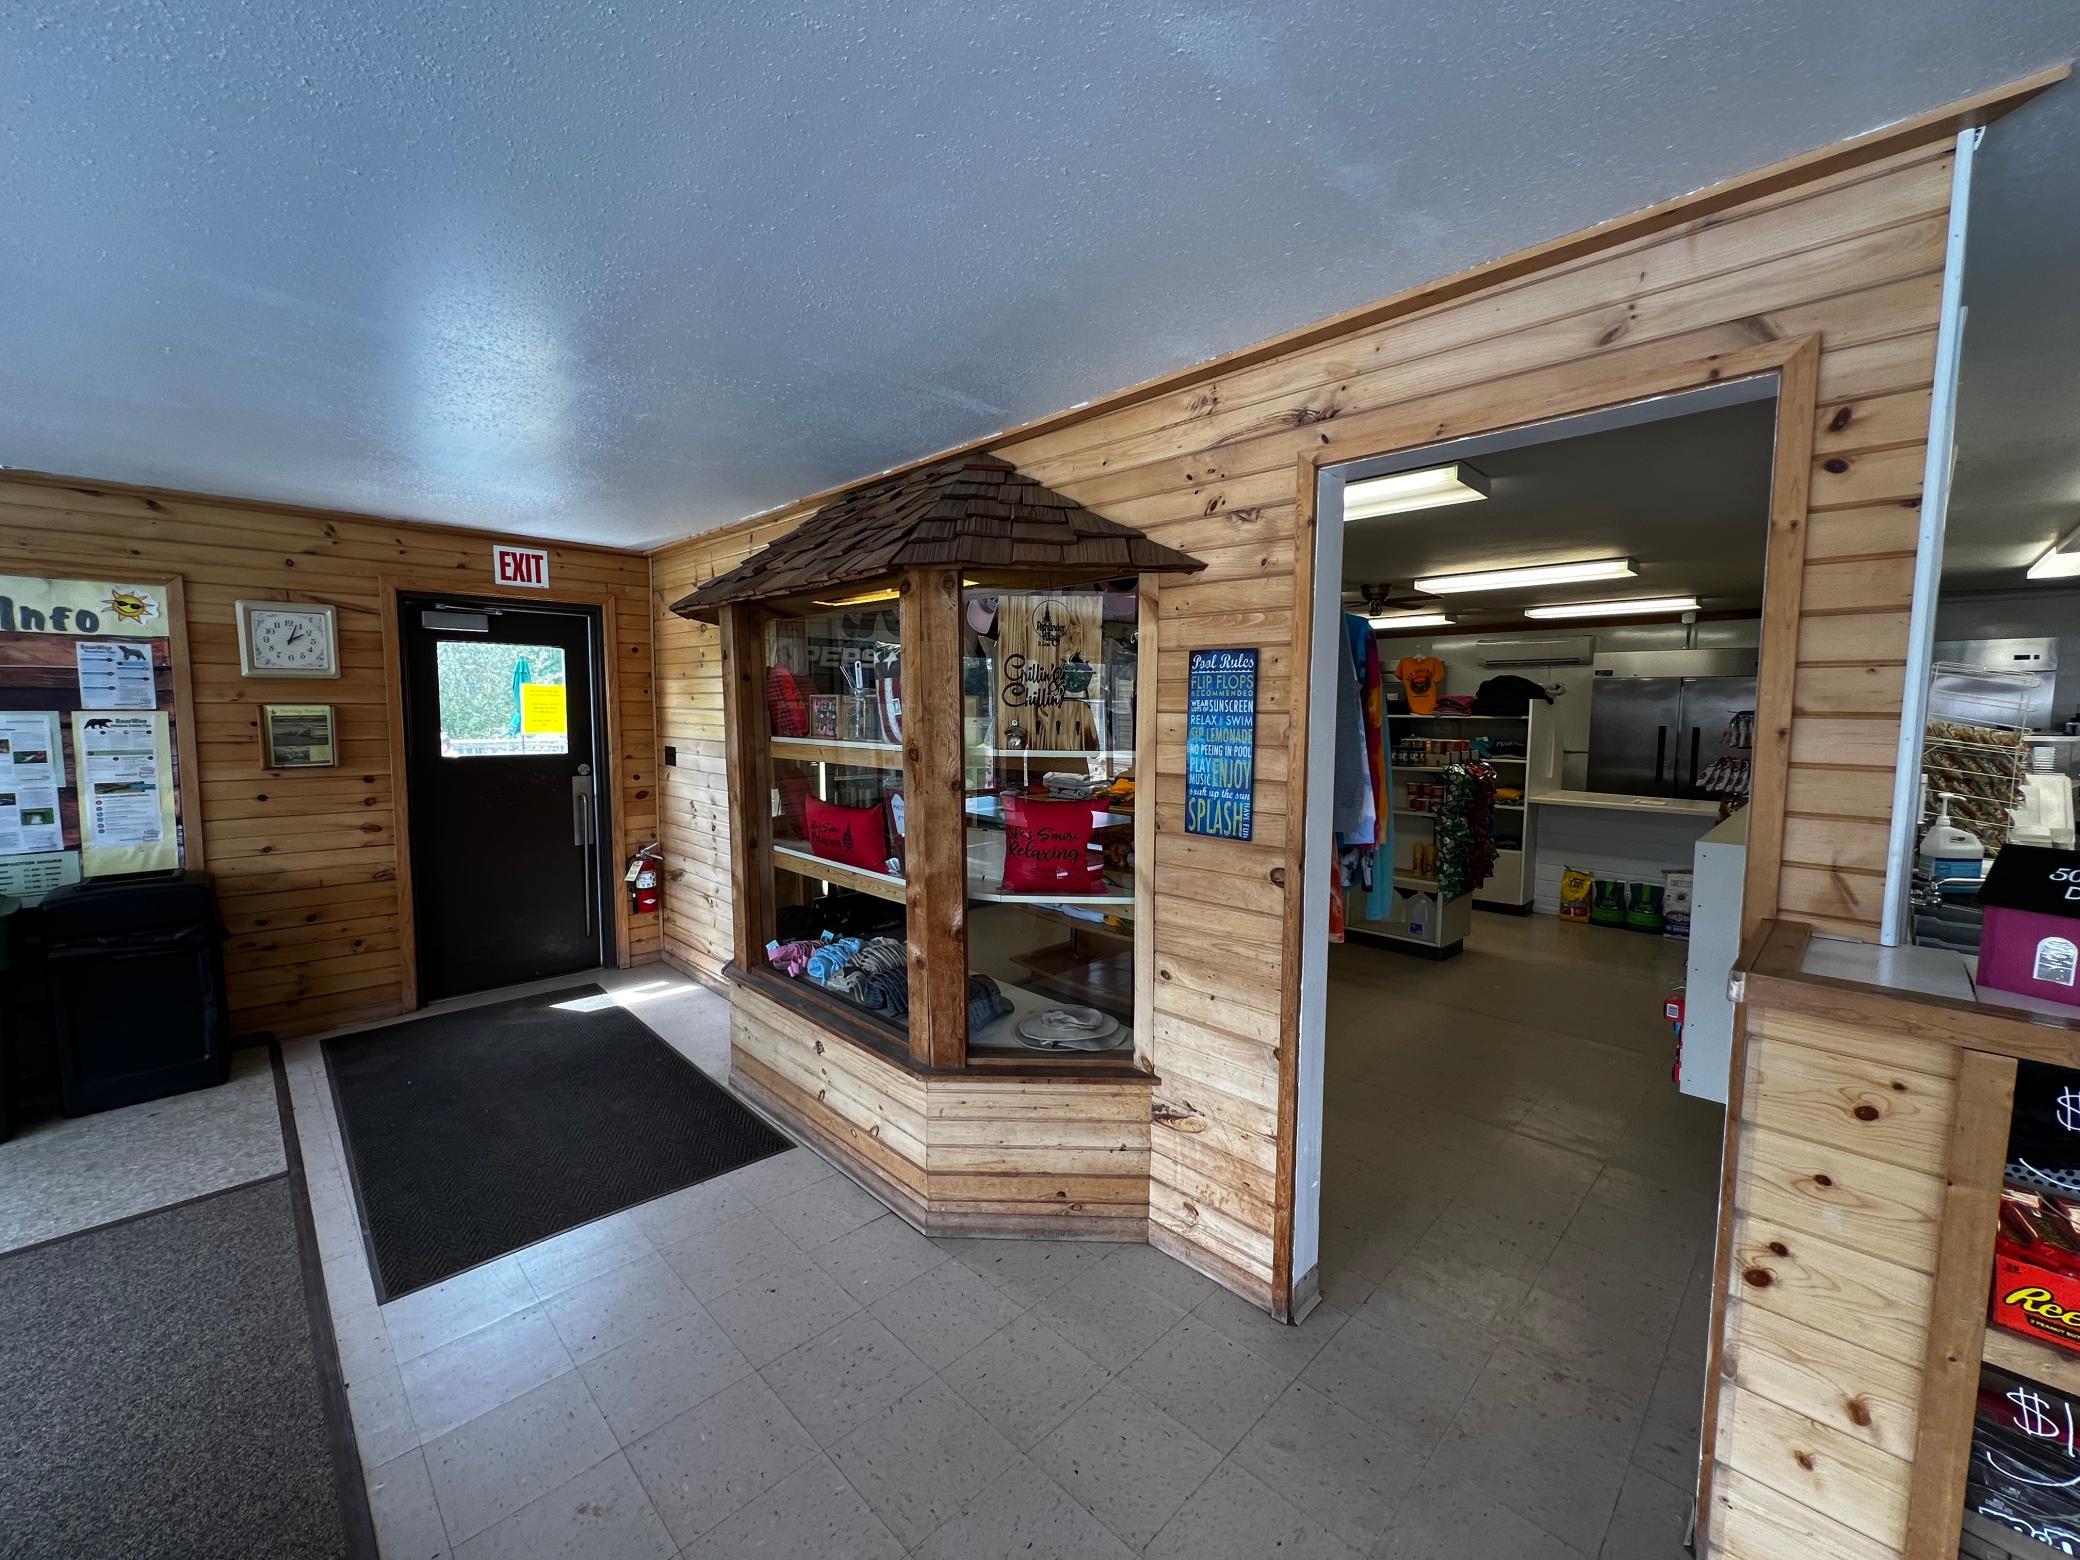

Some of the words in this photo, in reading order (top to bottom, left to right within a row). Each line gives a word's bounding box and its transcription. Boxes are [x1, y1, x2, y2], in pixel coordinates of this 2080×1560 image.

[499, 551, 543, 583] EXIT
[0, 595, 99, 633] Info
[1192, 654, 1216, 669] Pool
[1220, 653, 1254, 668] Rules
[1191, 675, 1212, 689] FLIP
[1216, 675, 1253, 689] FLOPS
[1209, 700, 1253, 712] SUNSCREEN
[1191, 715, 1216, 725] RELAX
[1226, 716, 1252, 726] SWIM
[1207, 728, 1252, 744] LEMONADE
[1190, 745, 1199, 754] NO
[1201, 745, 1223, 756] PEEING
[1225, 746, 1232, 756] IN
[1234, 746, 1251, 757] POOL
[1190, 757, 1211, 773] PLAY
[1189, 773, 1211, 785] MUSIC
[1212, 759, 1251, 789] ENJOY
[1222, 789, 1233, 798] the
[1189, 798, 1243, 837] SPLASH
[1008, 840, 1080, 864] Relaxing
